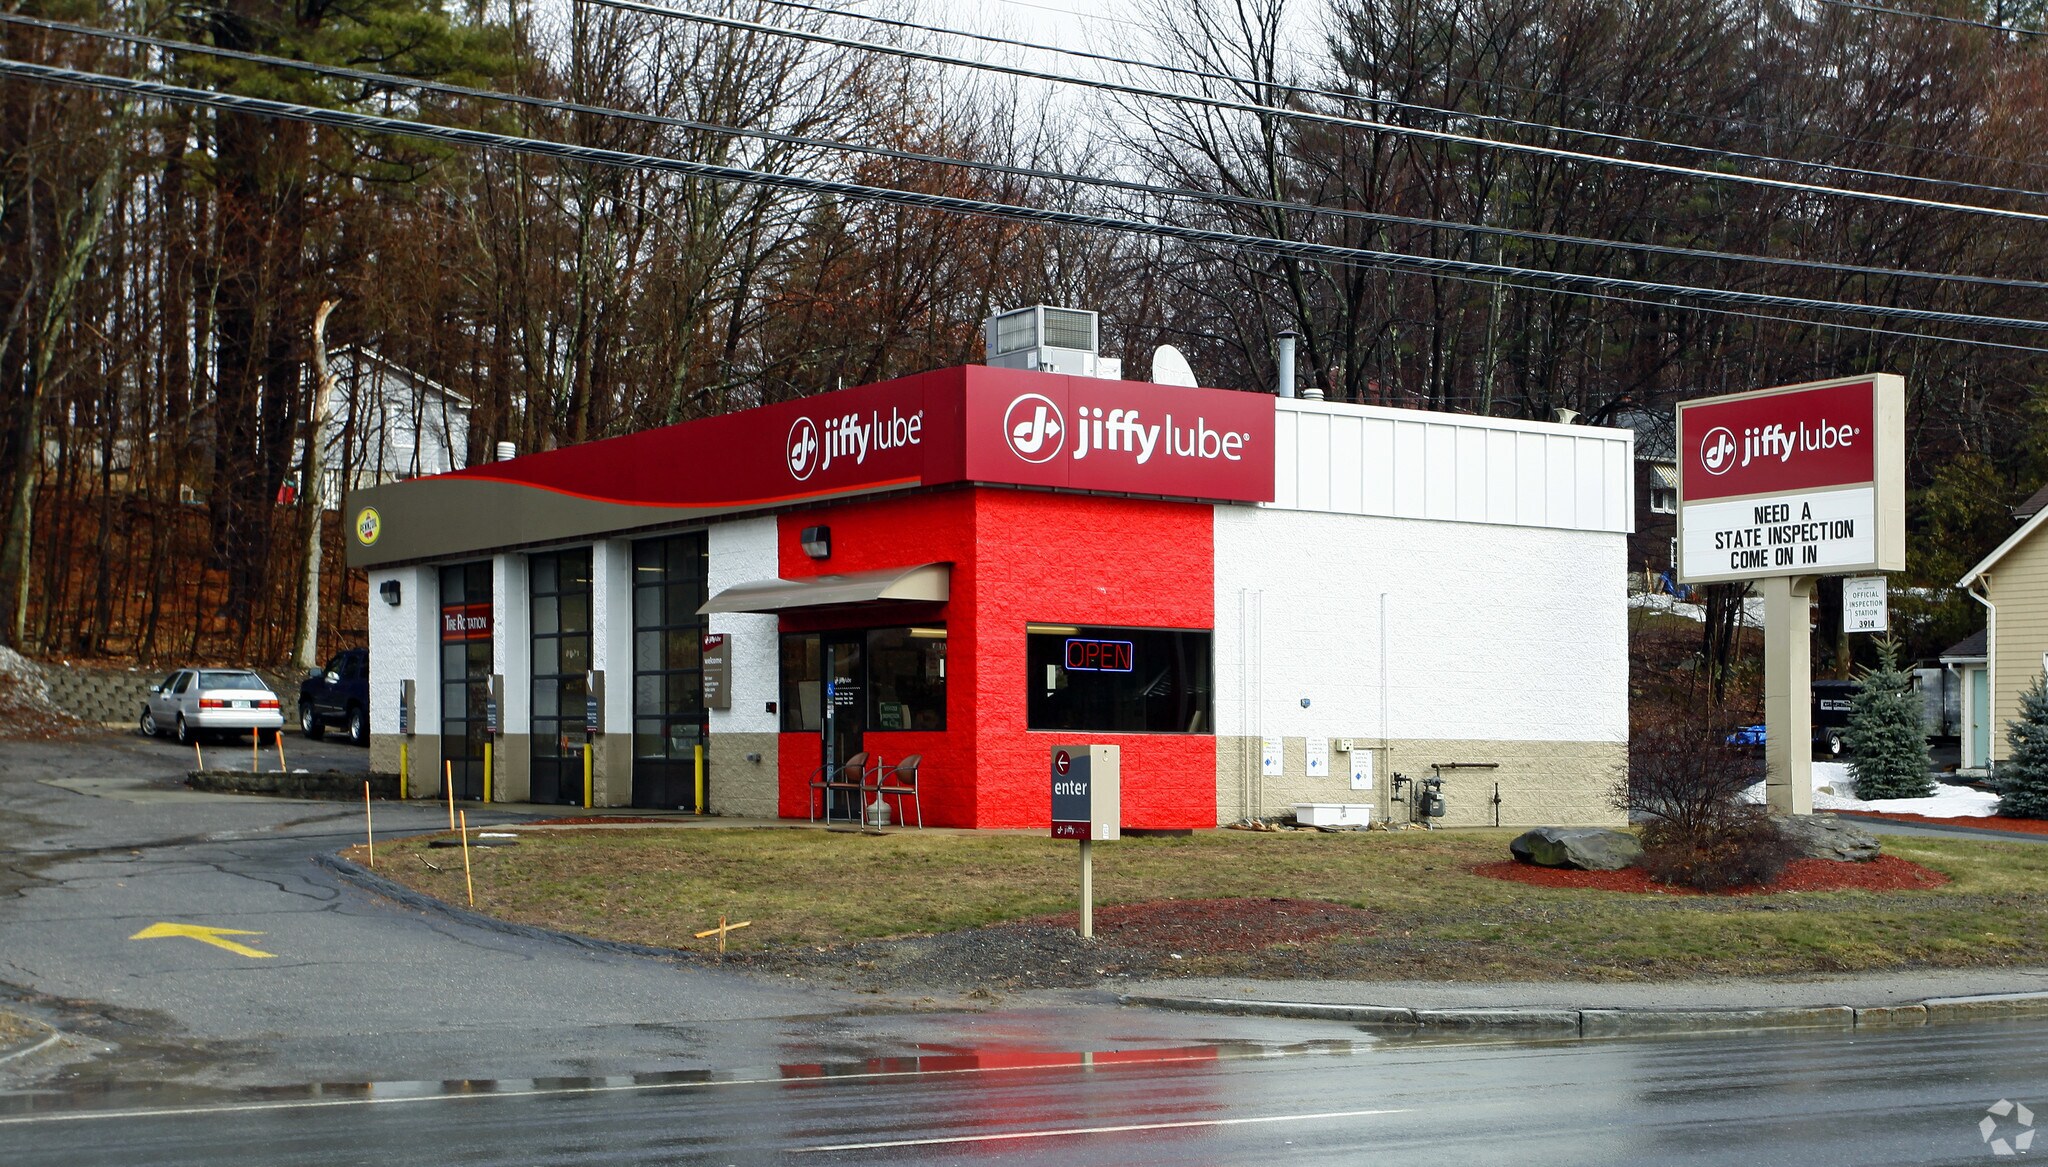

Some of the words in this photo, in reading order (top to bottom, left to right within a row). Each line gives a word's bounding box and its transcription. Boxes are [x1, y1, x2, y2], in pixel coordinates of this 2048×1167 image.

[1754, 503, 1790, 525] NEED
[1801, 501, 1812, 521] A
[1715, 528, 1762, 550] STATE
[1767, 519, 1854, 546] INSPECTION
[1730, 548, 1768, 570] COME
[1775, 546, 1793, 566] ON
[1802, 544, 1817, 564] IN
[1852, 591, 1879, 599] OFFICIAL
[1849, 599, 1883, 608] INSPECTION
[1854, 609, 1878, 617] STATION
[1859, 620, 1875, 628] 3914
[1068, 642, 1130, 669] OPEN
[1054, 780, 1088, 796] enter
